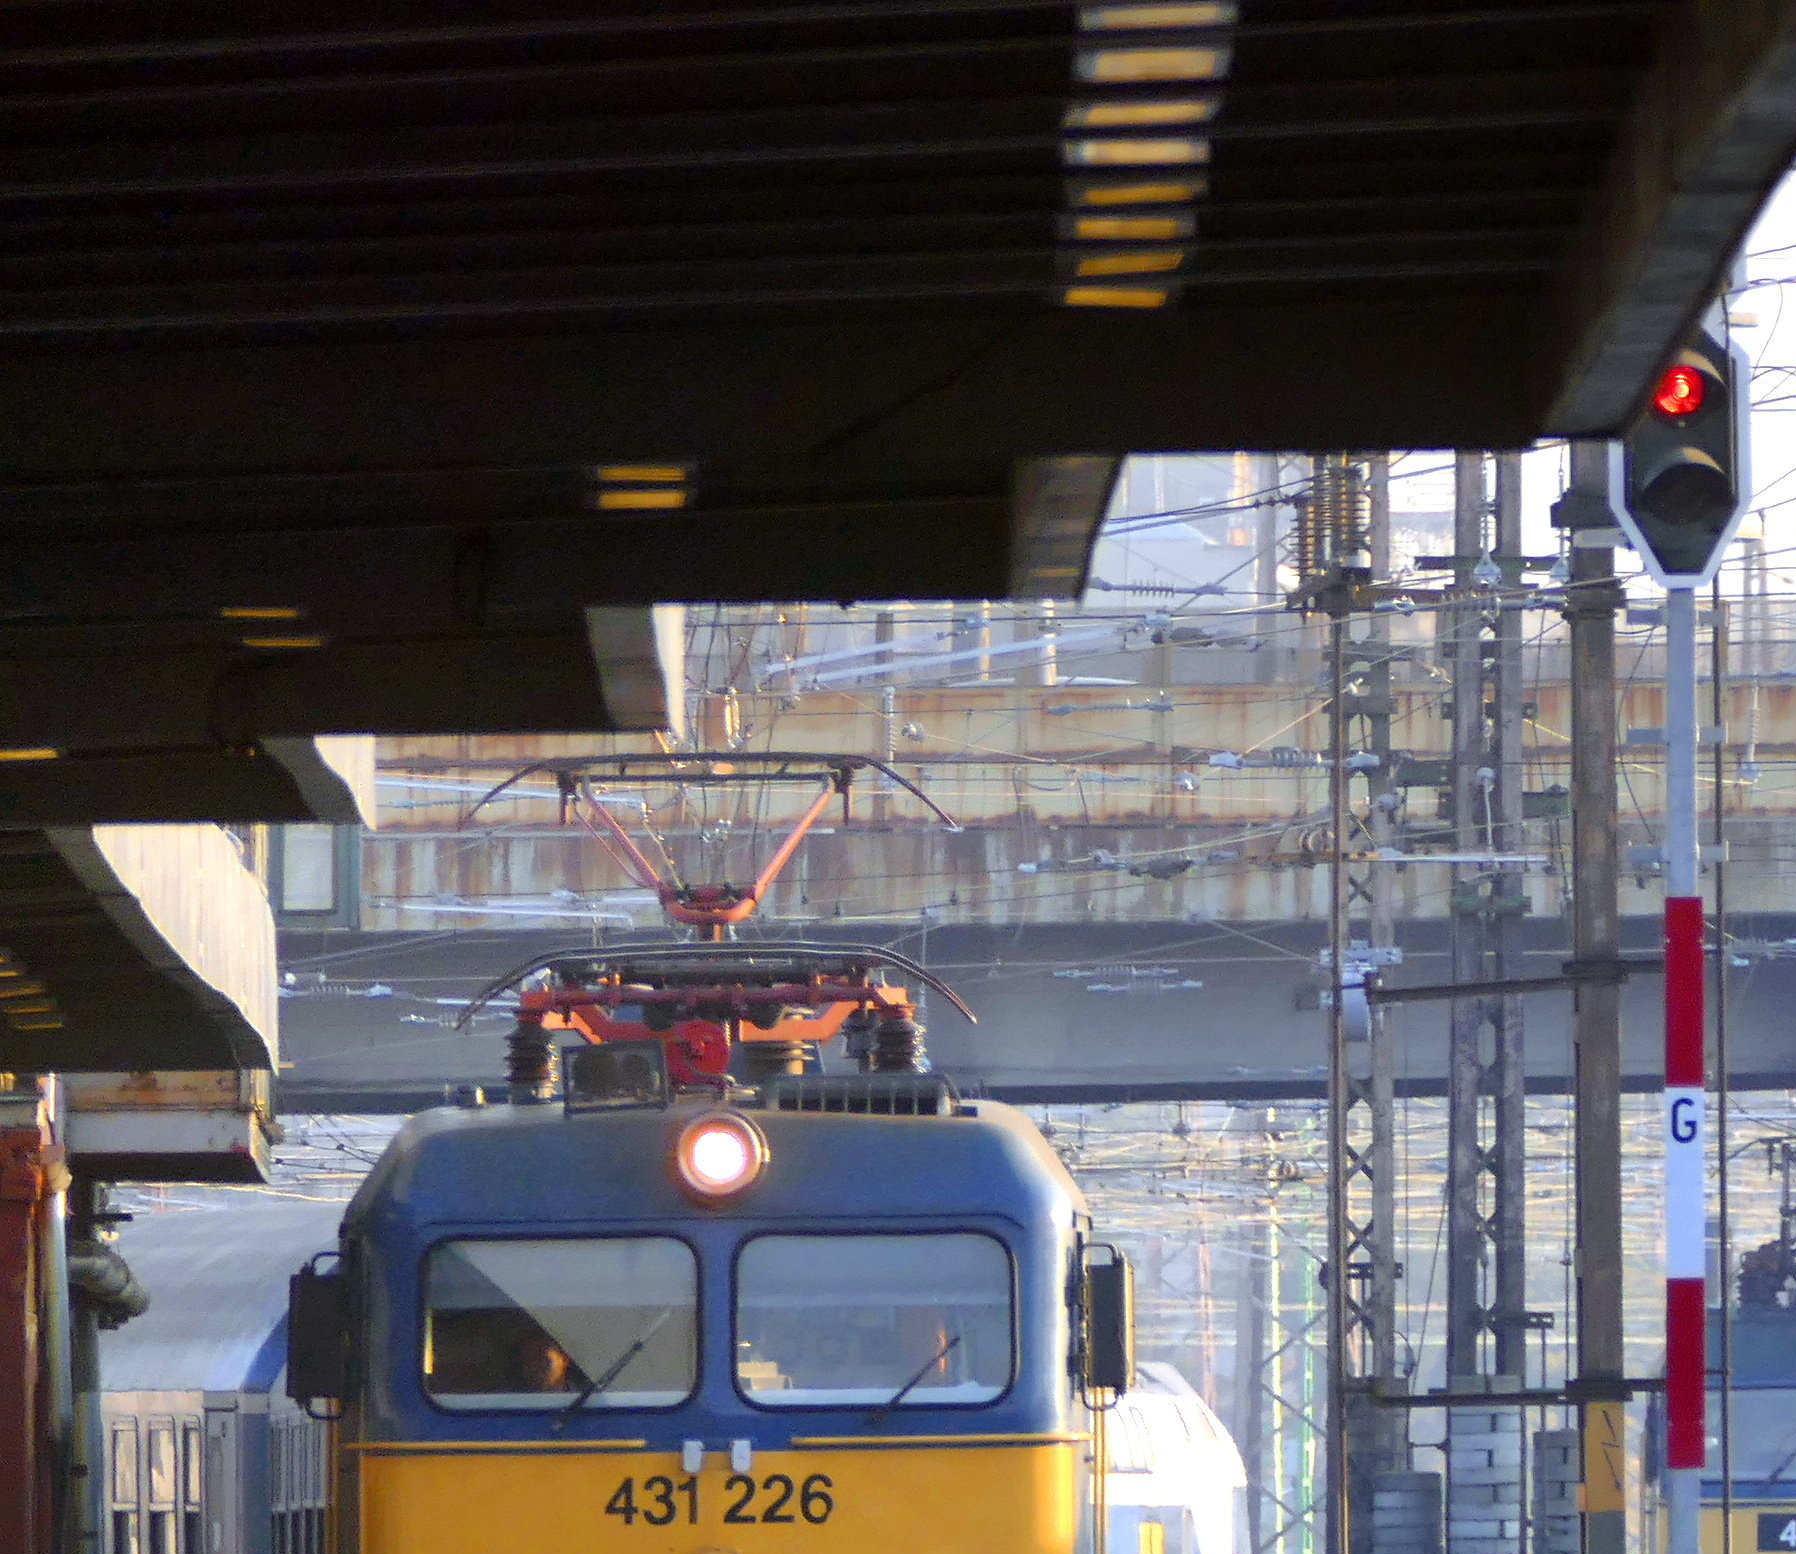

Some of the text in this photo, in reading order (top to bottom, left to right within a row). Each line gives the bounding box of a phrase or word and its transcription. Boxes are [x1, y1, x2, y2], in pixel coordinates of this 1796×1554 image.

[1671, 1097, 1698, 1144] G
[604, 1473, 835, 1526] 431 226
